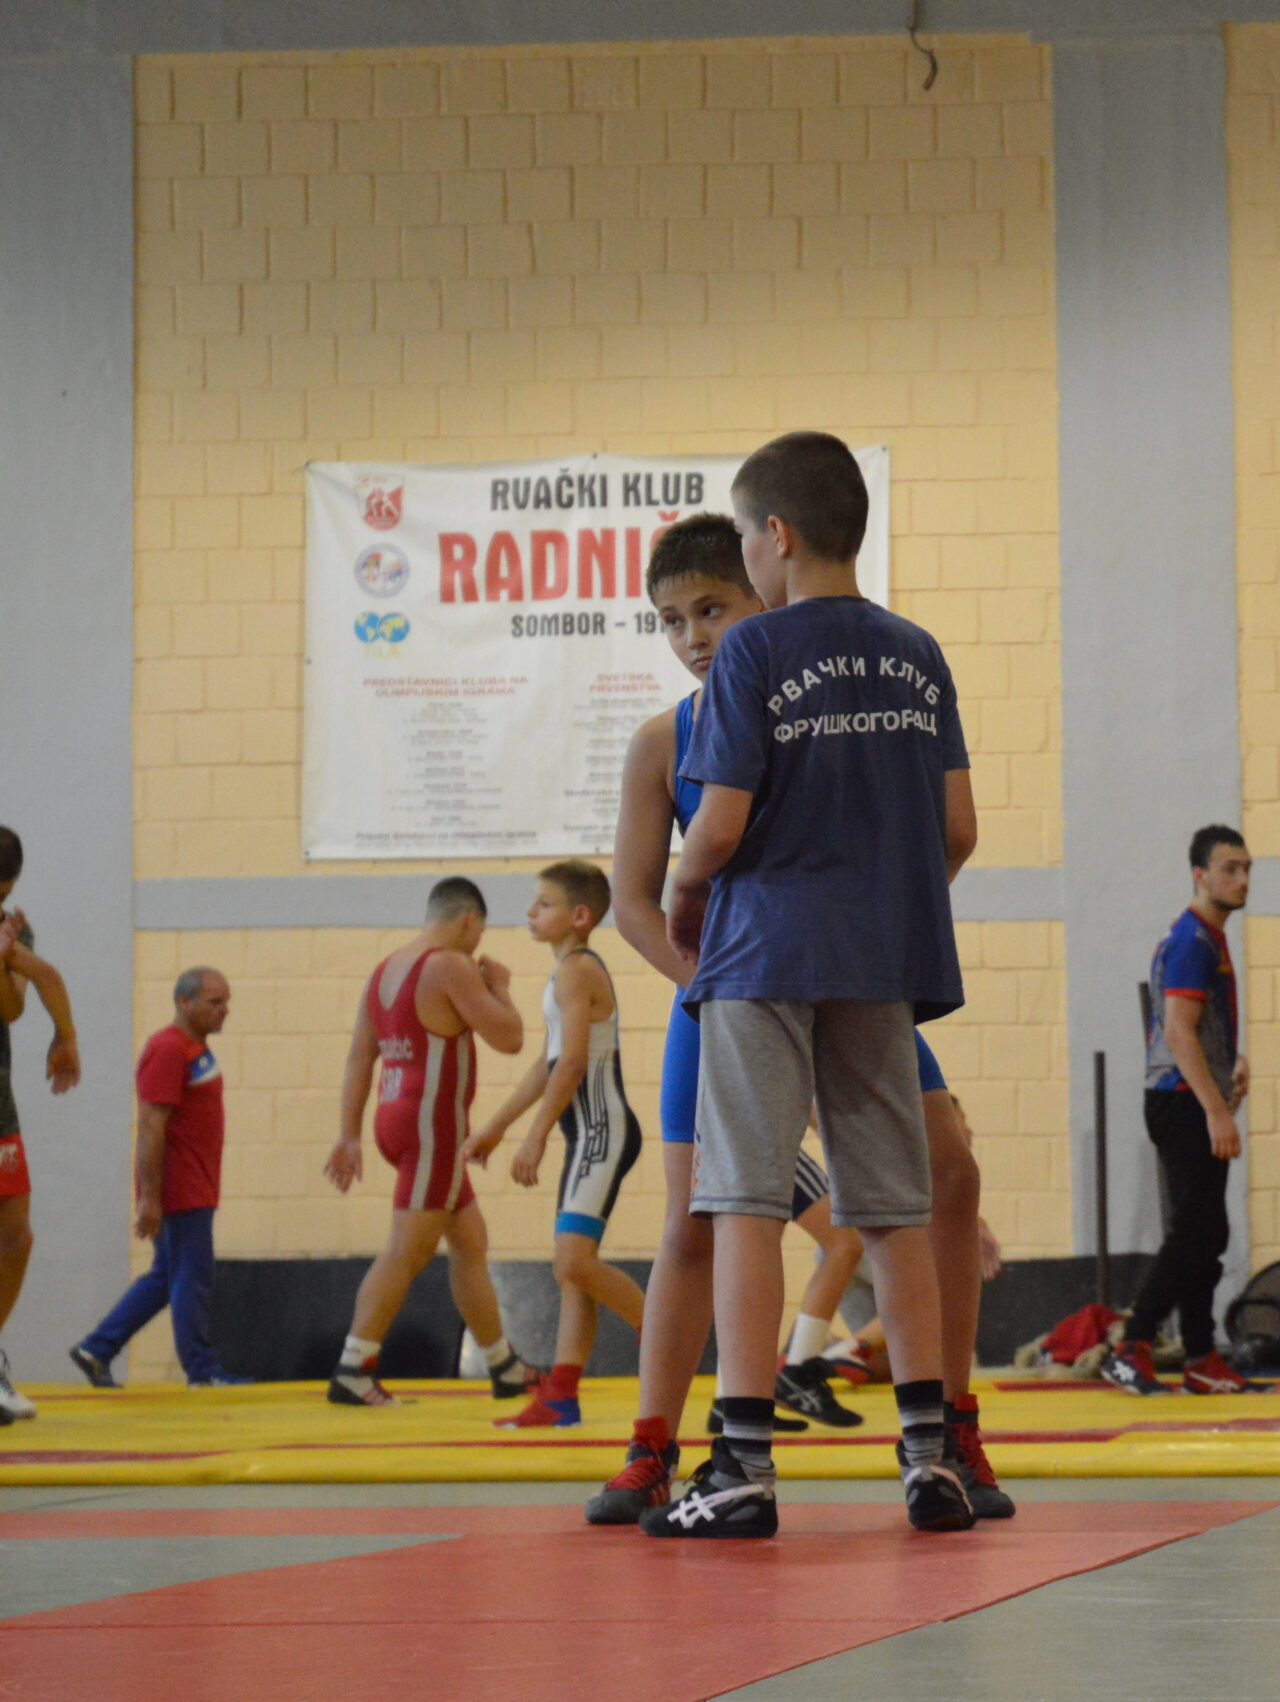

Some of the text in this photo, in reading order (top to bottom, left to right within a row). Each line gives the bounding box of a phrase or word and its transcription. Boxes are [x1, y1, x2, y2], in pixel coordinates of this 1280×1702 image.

[490, 468, 704, 511] RVAČKI KLUB
[511, 612, 606, 637] SOMBOR
[767, 656, 940, 716] РВАЧКИ КЛУБ
[774, 709, 937, 744] ФРУШКОГОРАЦ
